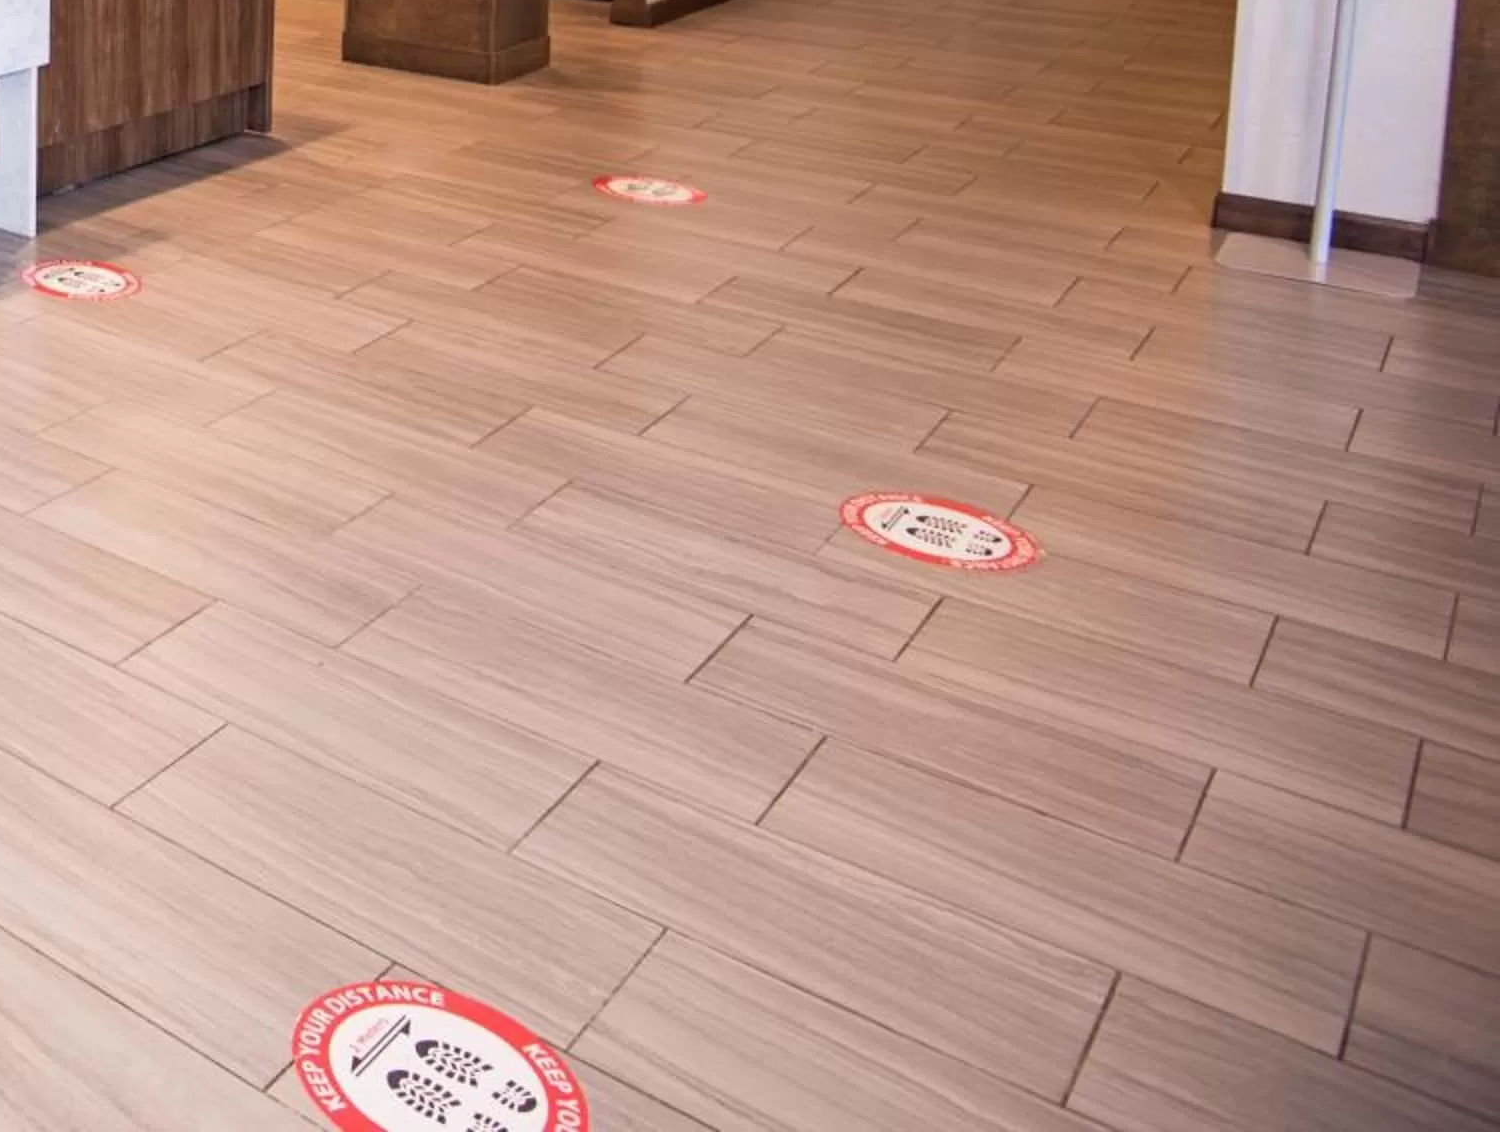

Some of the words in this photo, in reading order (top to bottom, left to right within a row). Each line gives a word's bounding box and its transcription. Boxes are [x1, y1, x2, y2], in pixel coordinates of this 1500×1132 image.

[323, 984, 445, 1013] DISTANCE
[299, 1008, 335, 1056] YOUR
[300, 1060, 348, 1111] KEEP
[522, 1043, 573, 1094] KEEP
